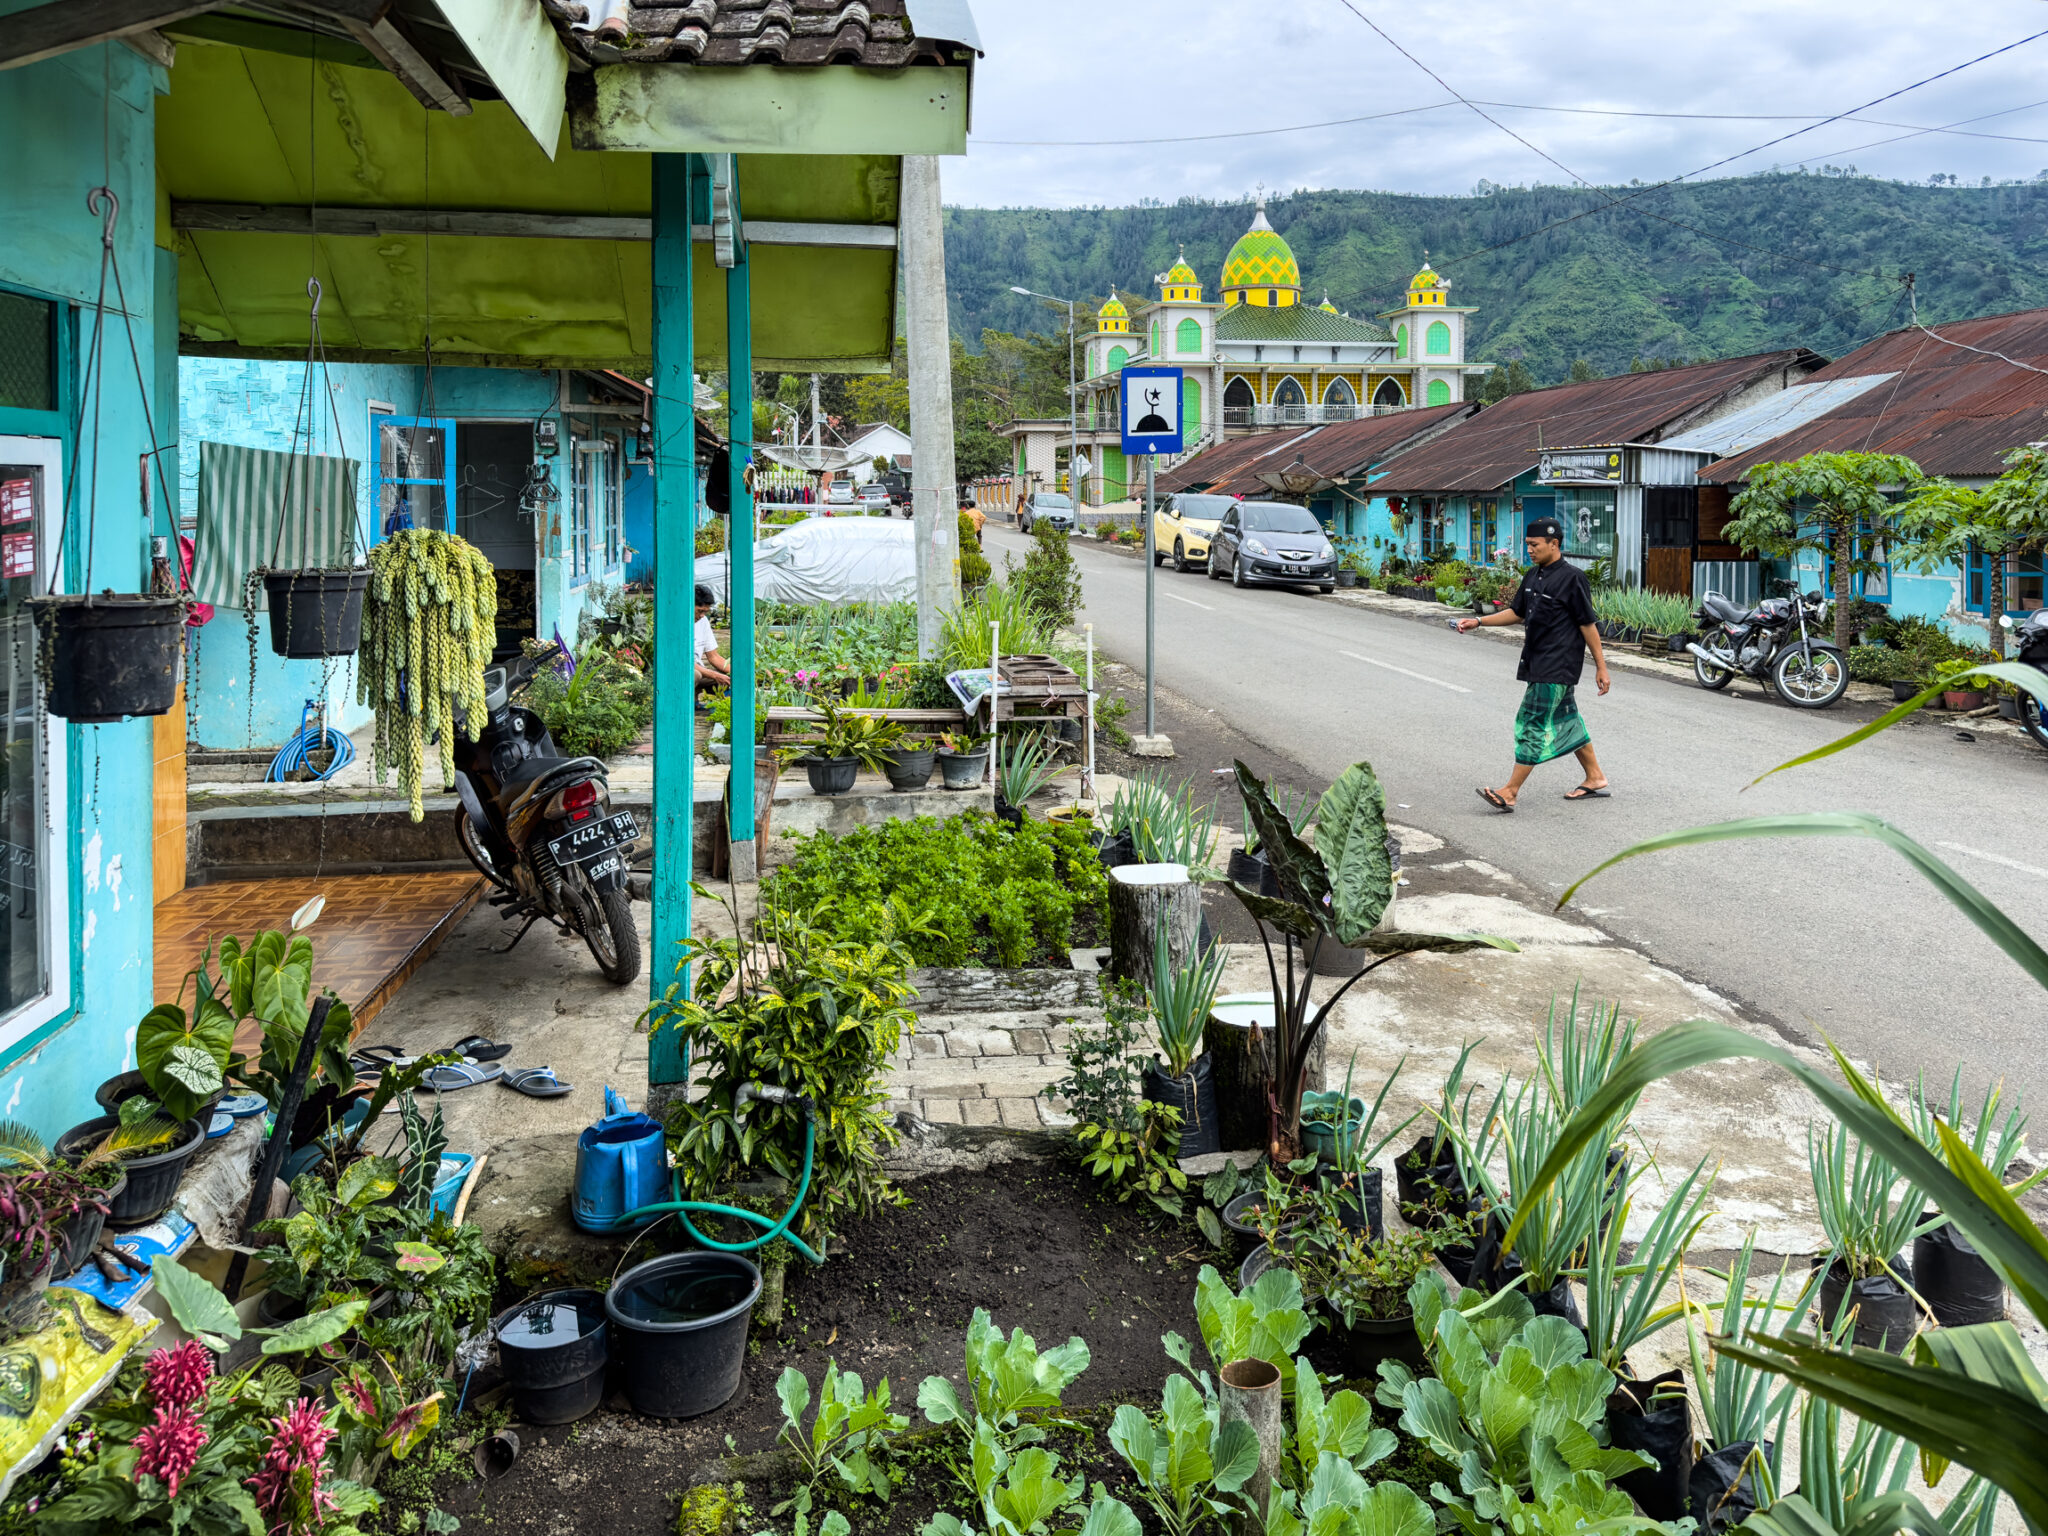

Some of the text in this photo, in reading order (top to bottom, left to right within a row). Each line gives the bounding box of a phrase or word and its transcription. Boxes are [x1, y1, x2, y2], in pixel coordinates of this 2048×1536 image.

[552, 814, 632, 854] P 4424 BH
